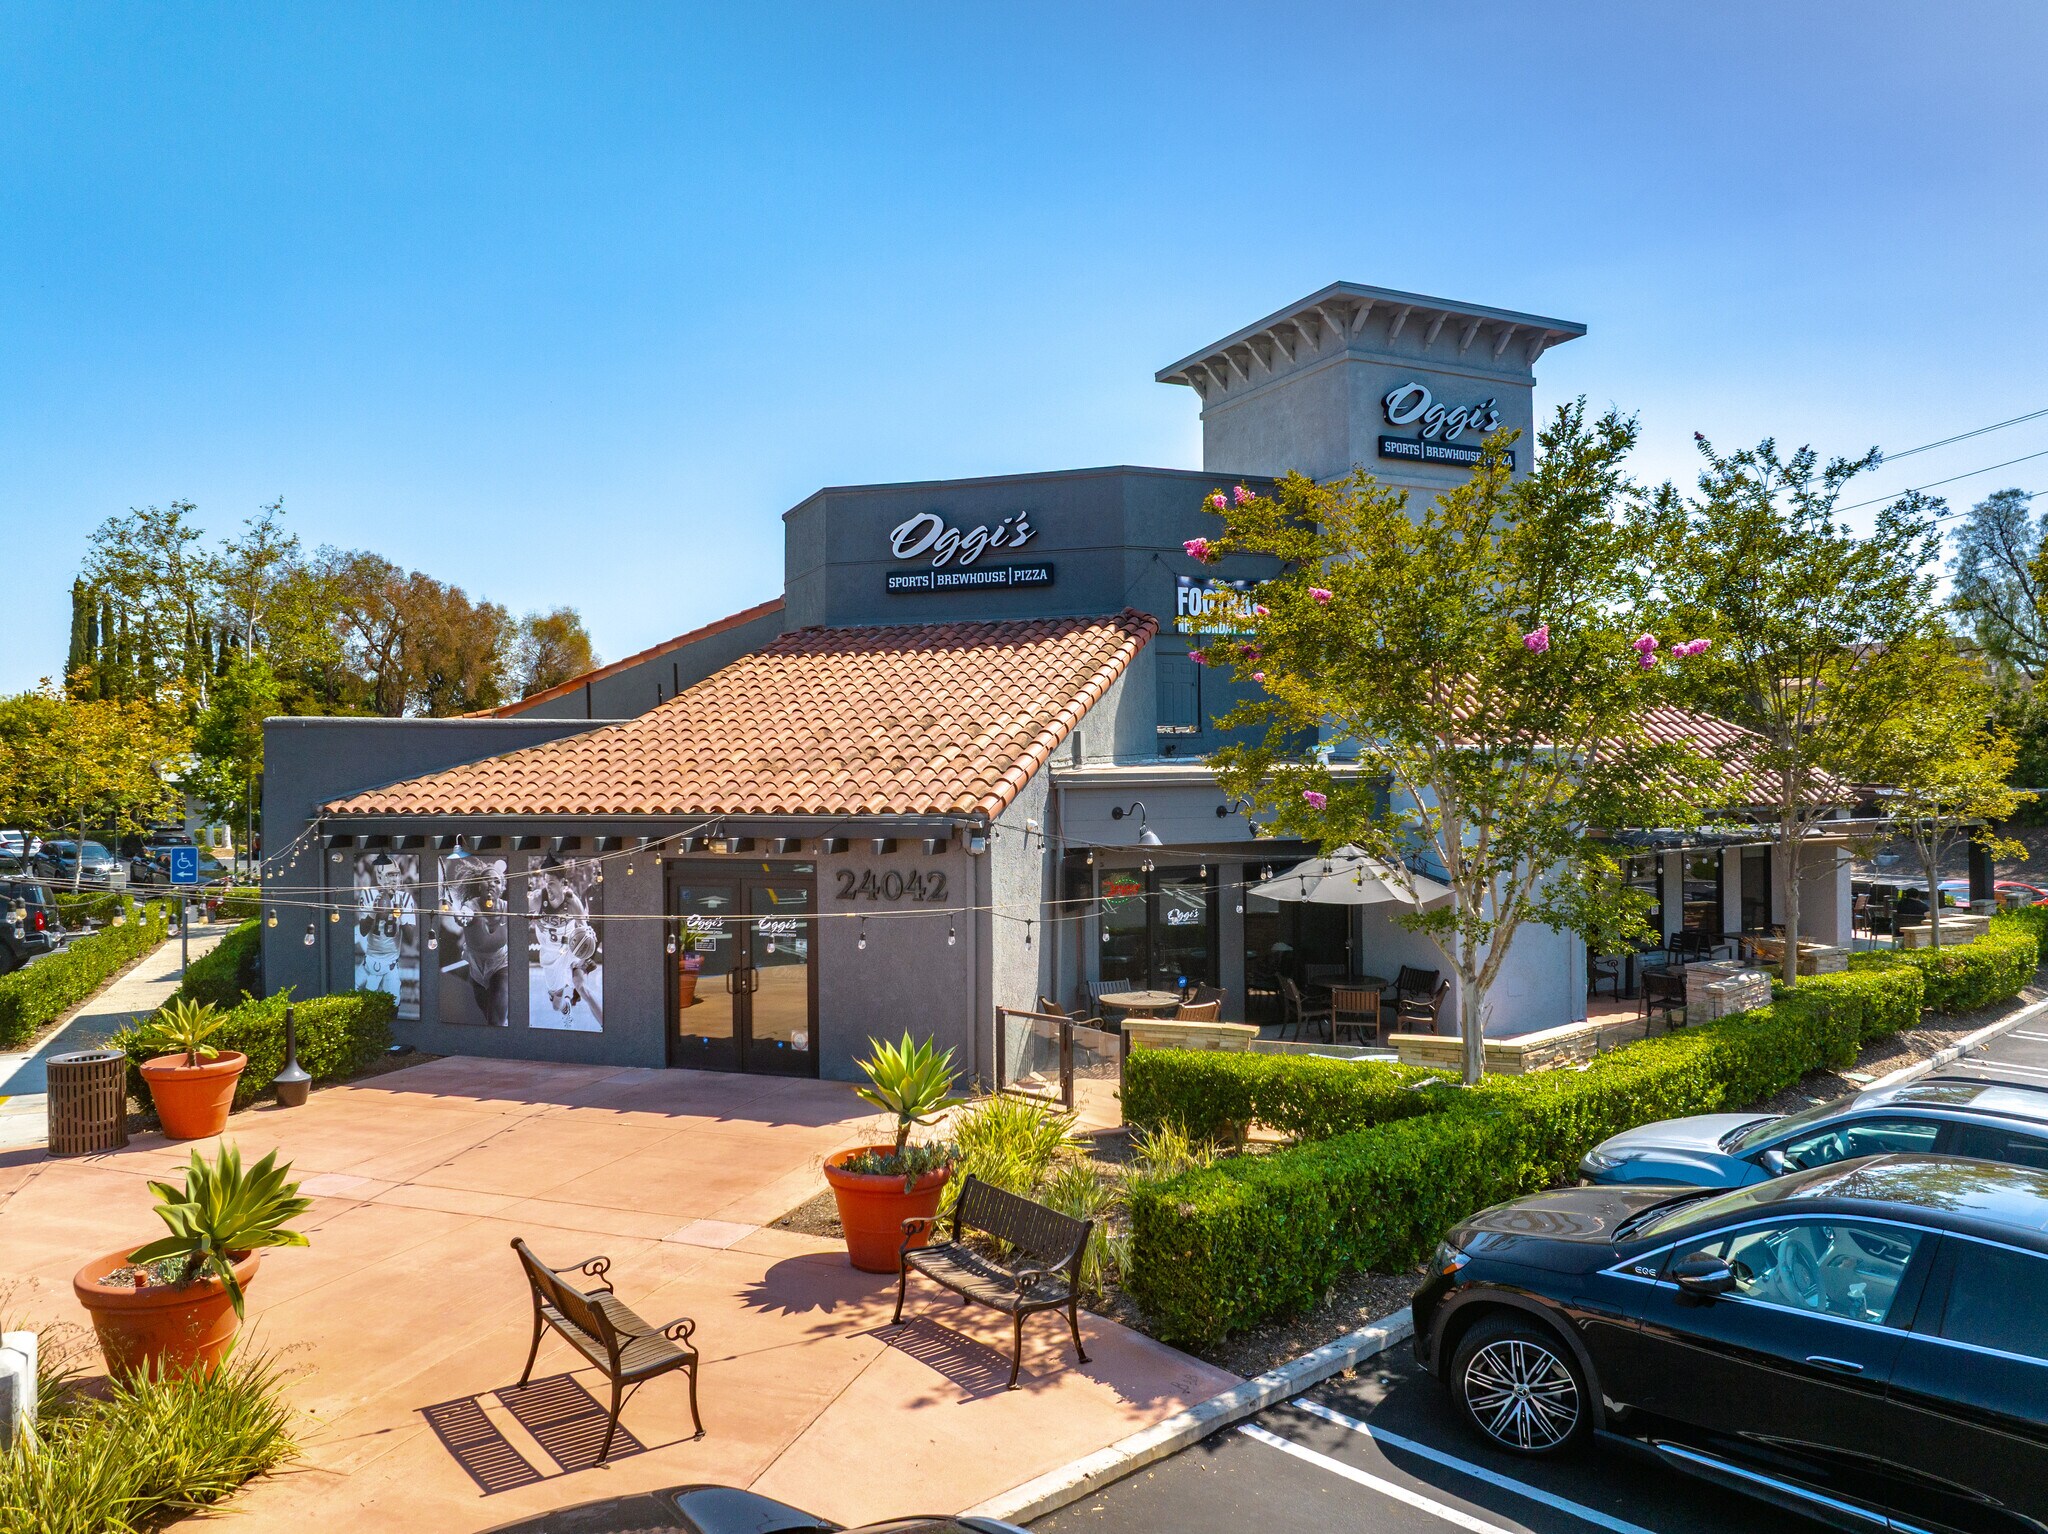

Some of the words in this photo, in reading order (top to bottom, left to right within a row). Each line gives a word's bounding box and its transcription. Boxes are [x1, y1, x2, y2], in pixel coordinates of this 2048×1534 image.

[1386, 382, 1505, 441] Oggi's
[1384, 441, 1420, 455] SPORTS
[1426, 446, 1481, 462] BREWHOUSE
[889, 510, 1037, 568] Oggi's
[888, 575, 929, 589] SPORTS
[937, 571, 1007, 586] BREWHOUSE
[1013, 568, 1048, 582] PIZZA
[836, 868, 949, 902] 24042
[686, 914, 725, 931] Oggi's
[758, 915, 798, 933] Oggi's
[1634, 1265, 1657, 1277] EQE
